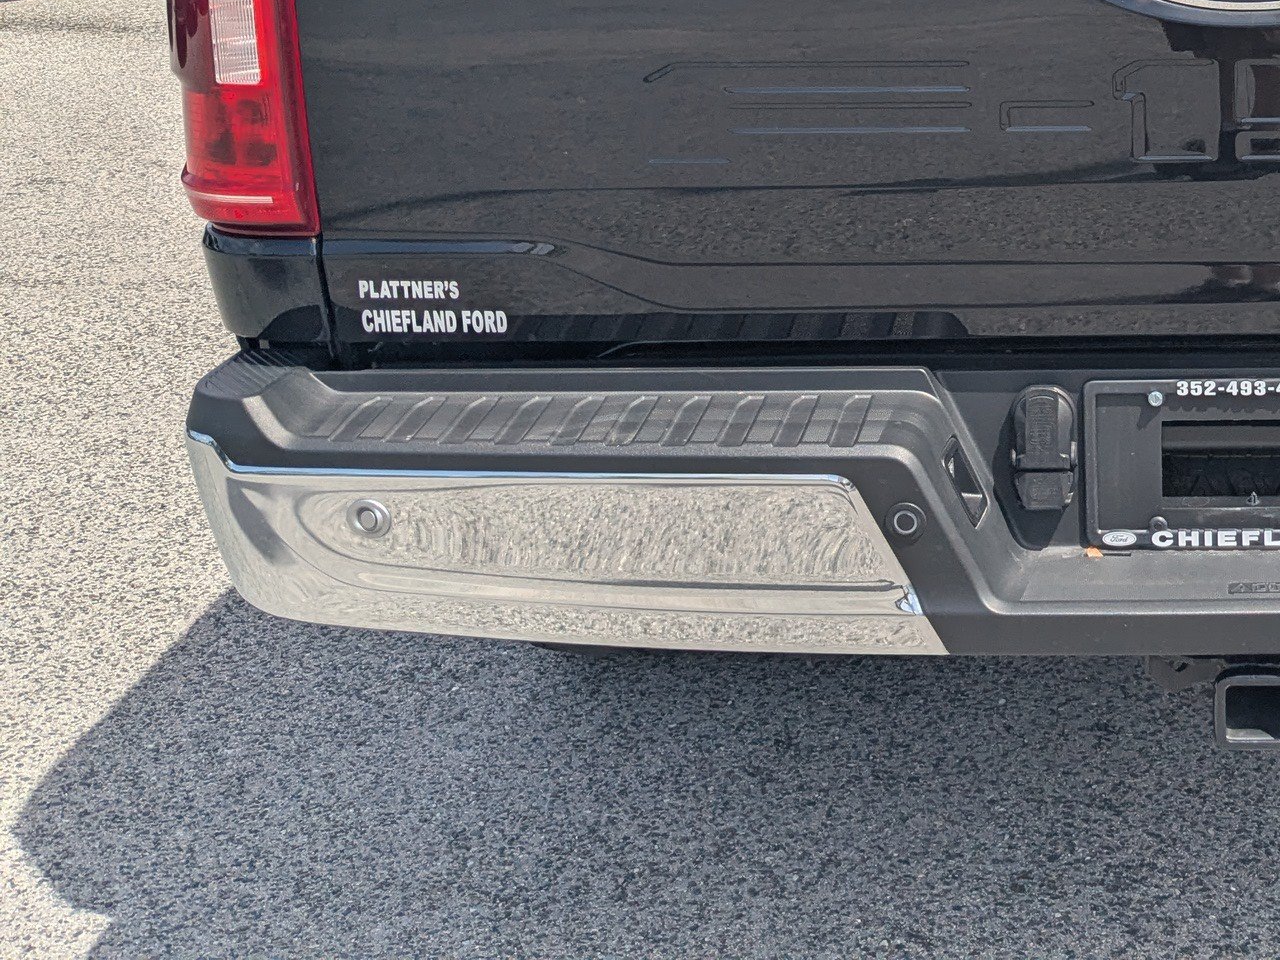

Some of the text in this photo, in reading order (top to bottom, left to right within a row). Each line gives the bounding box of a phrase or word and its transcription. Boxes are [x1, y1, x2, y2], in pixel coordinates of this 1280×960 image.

[358, 280, 460, 299] PLATTNER'S
[361, 309, 508, 333] CHIEFLAND FORD
